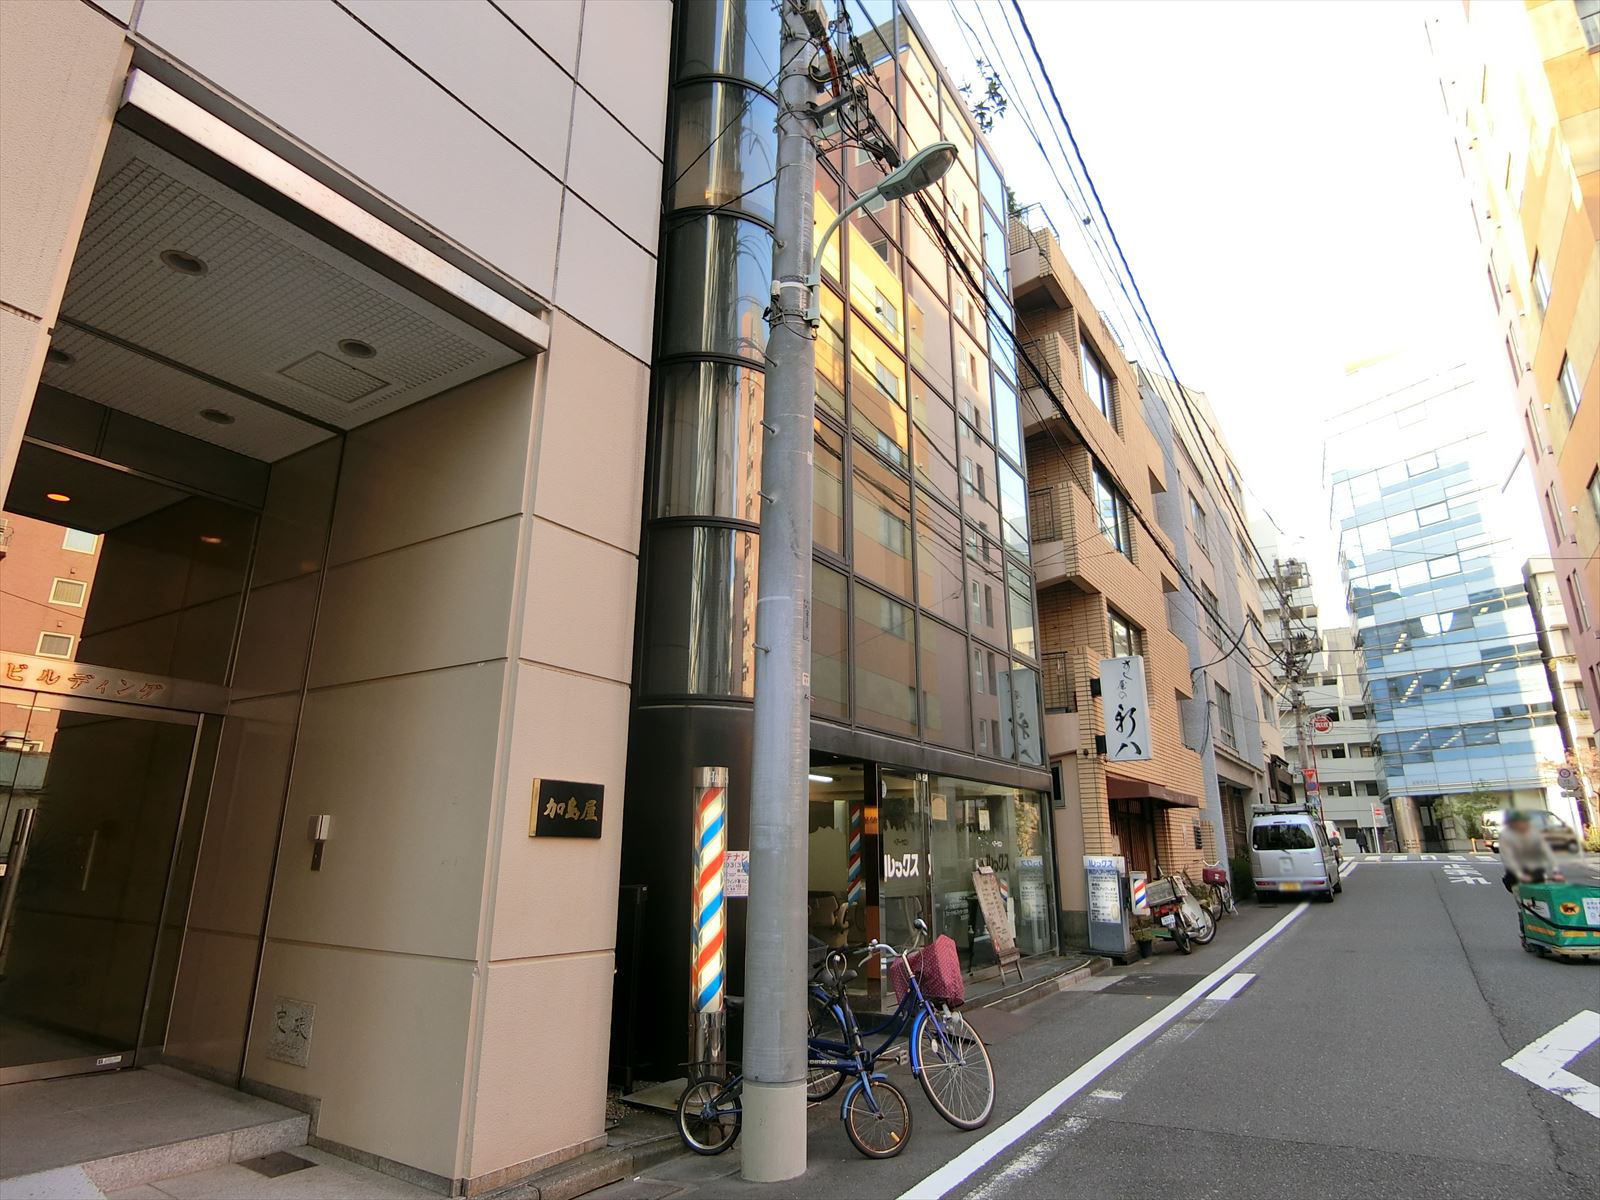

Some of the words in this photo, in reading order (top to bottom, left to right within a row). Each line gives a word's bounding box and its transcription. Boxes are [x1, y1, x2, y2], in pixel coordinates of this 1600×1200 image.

[6, 662, 164, 700] ビルディング
[543, 796, 598, 822] 加島屋
[884, 853, 919, 882] ルックス
[1088, 860, 1114, 868] ルックス
[1441, 863, 1492, 885] 止まれ
